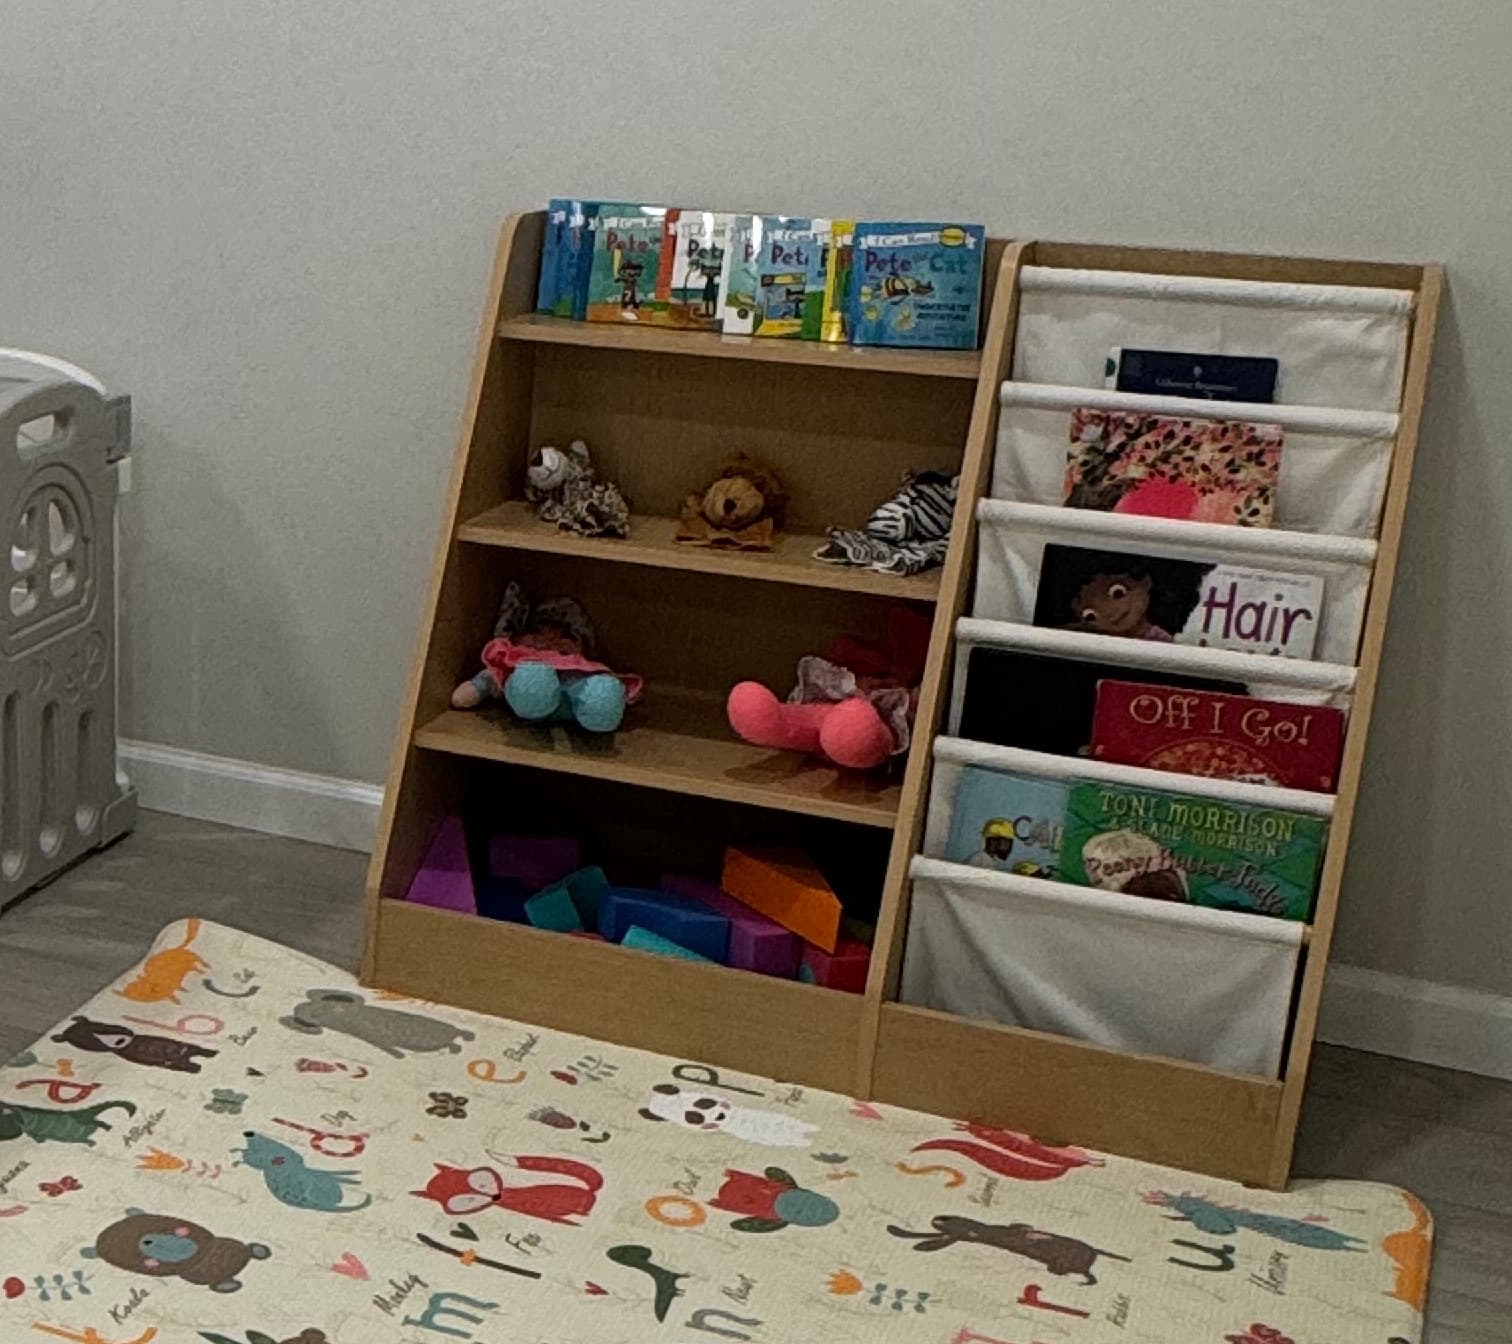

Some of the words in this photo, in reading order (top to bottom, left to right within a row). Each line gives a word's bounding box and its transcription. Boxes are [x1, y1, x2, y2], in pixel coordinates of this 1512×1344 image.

[771, 241, 809, 266] Pet
[865, 250, 911, 272] Pete
[1202, 582, 1313, 645] Hair
[1129, 694, 1199, 729] Off
[1208, 702, 1224, 734] I
[1241, 708, 1312, 746] Go!
[1100, 790, 1160, 817] TONI
[1168, 802, 1295, 841] MORRISON
